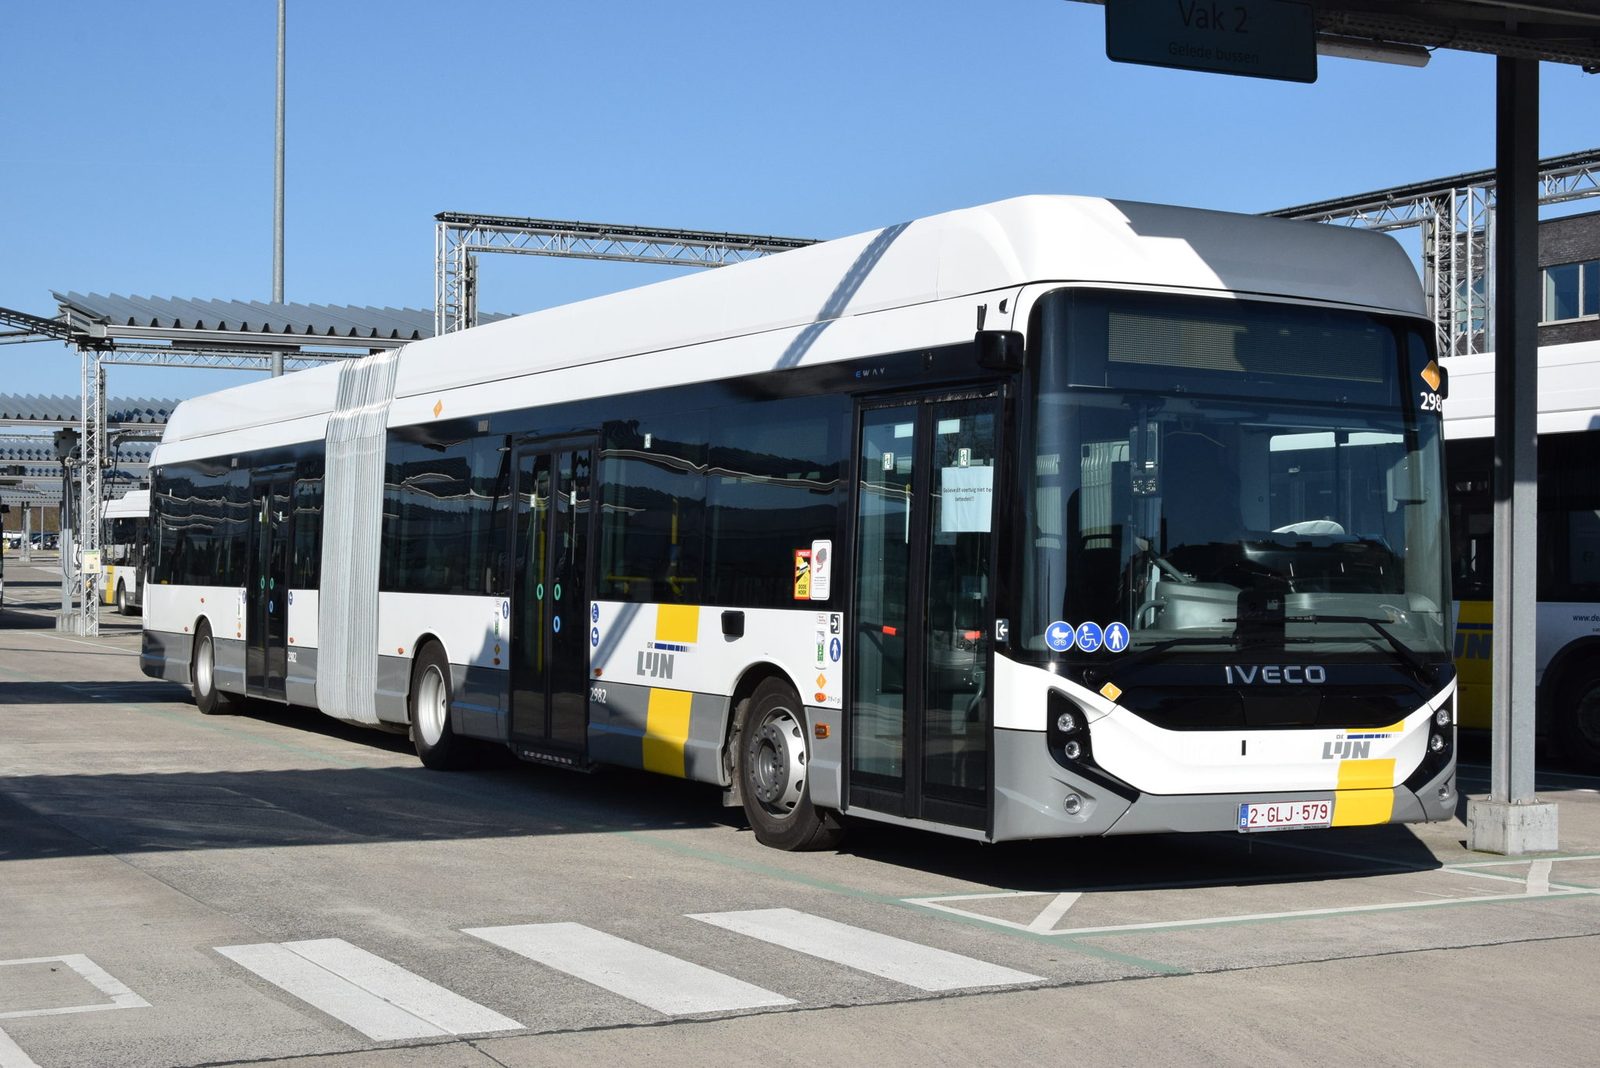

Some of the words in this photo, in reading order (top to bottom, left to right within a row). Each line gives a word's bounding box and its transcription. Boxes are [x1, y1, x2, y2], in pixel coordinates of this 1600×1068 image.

[1178, 0, 1225, 31] Vak
[1234, 6, 1249, 33] 2
[1168, 42, 1212, 60] Gelede
[1215, 47, 1260, 65] bussen
[1420, 391, 1442, 412] 298
[1225, 665, 1326, 684] IVECO
[590, 687, 607, 704] 2982
